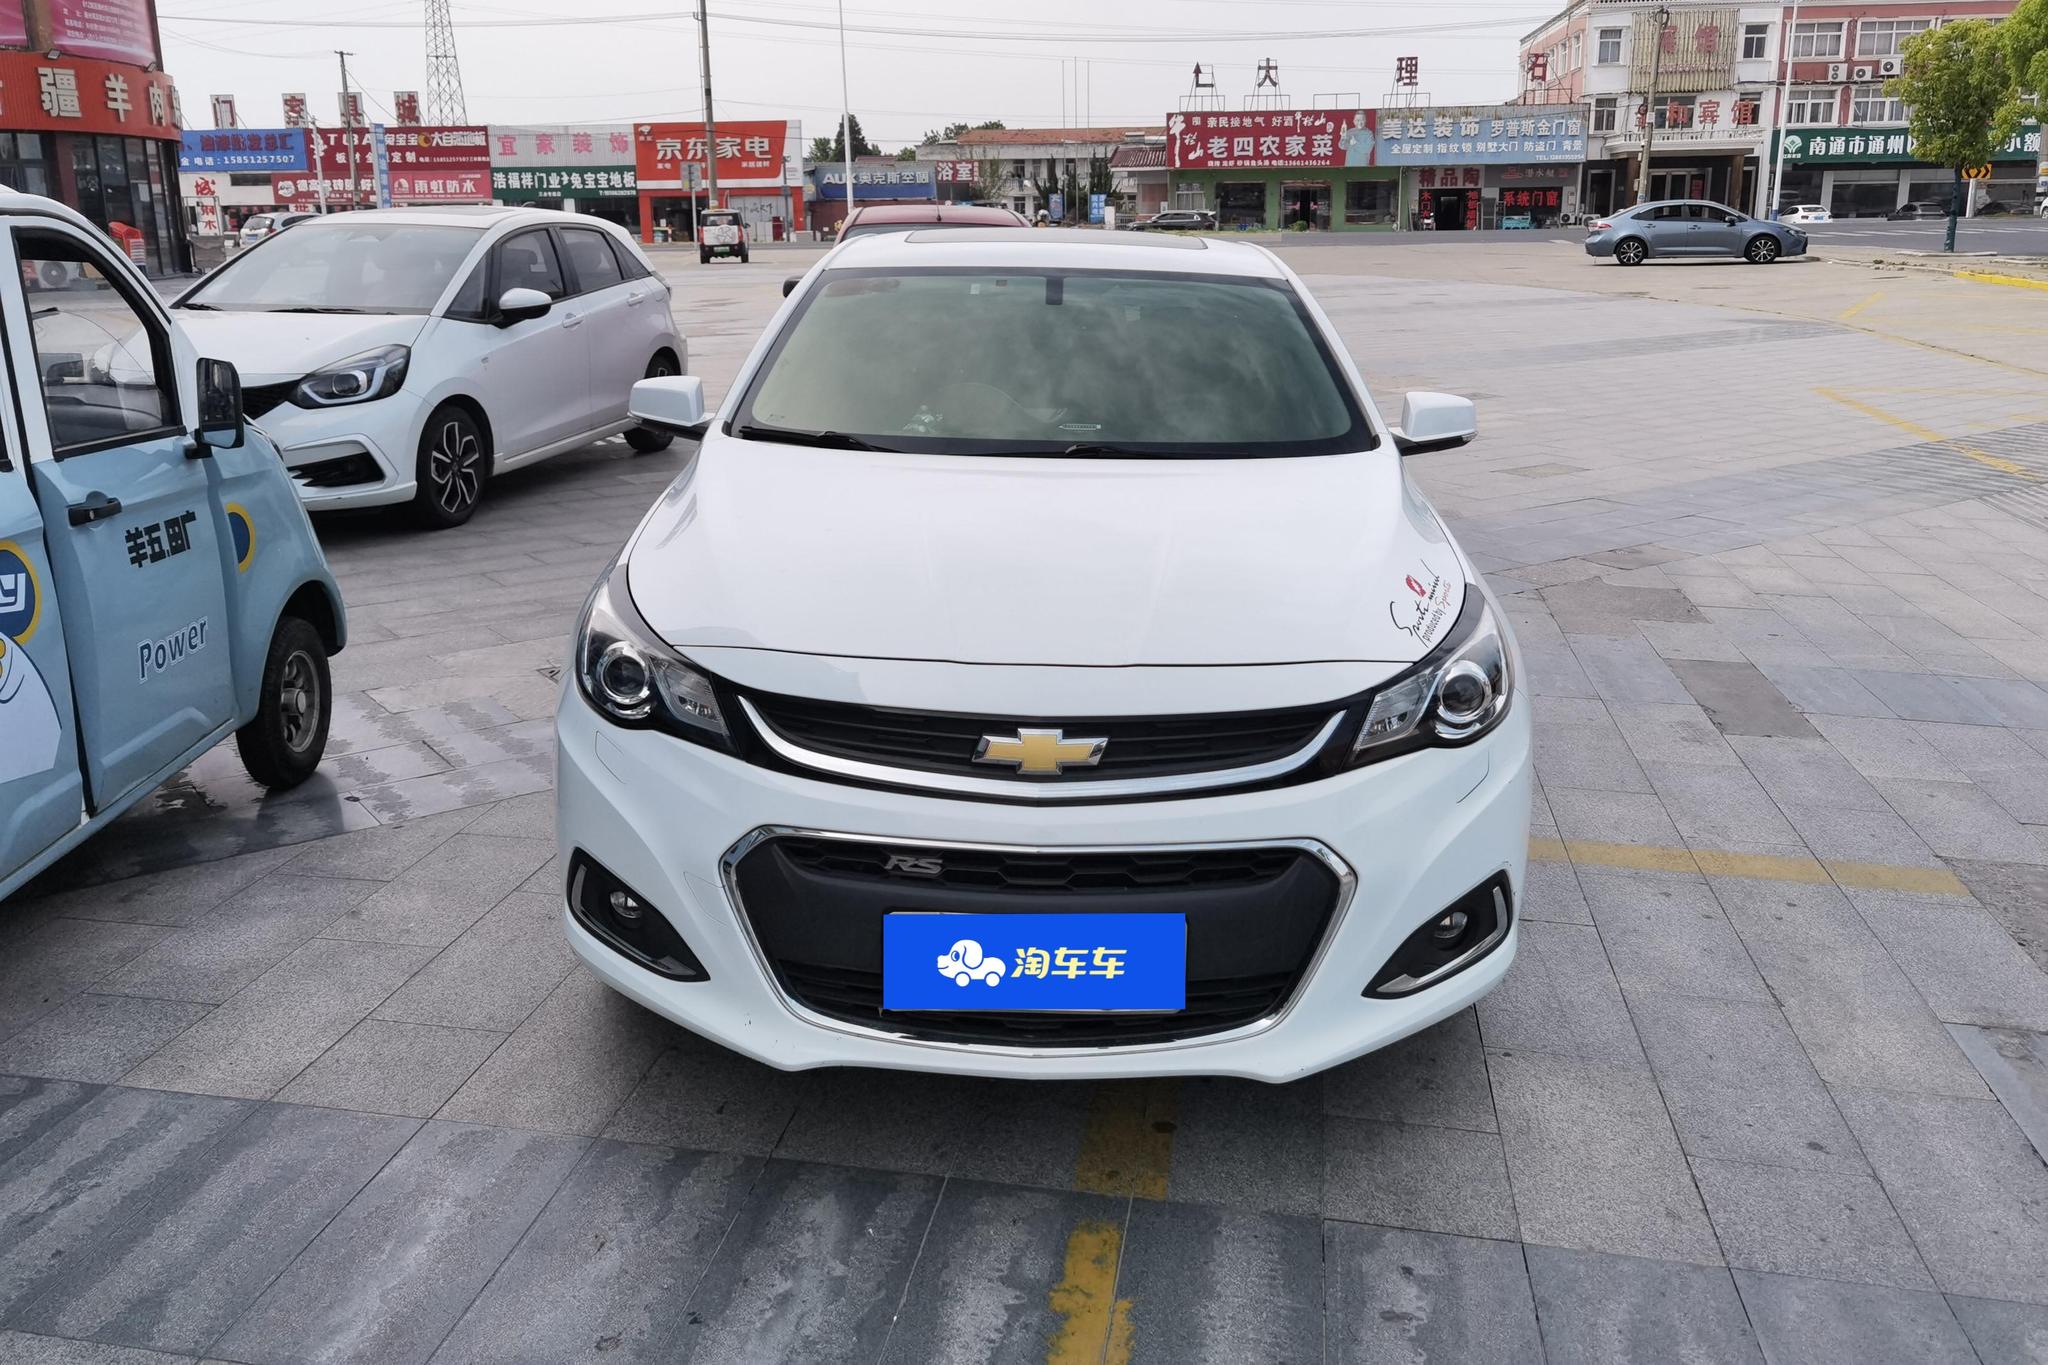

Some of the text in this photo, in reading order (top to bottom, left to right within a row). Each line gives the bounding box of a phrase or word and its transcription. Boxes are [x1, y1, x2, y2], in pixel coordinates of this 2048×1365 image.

[0, 67, 182, 129] 疆羊肉
[1207, 116, 1265, 128] 亲民接地气
[1382, 116, 1582, 140] 美达装饰 罗普斯金门窗
[497, 132, 629, 156] 宜家装饰
[656, 136, 772, 161] 京东家电
[1207, 134, 1334, 158] 老四农家菜
[1391, 143, 1433, 154] 全屋定制
[1437, 142, 1472, 154] 指纹锁
[1476, 141, 1518, 153] 别墅大门
[1523, 141, 1556, 152] 防盗门
[493, 171, 636, 189] 浩福祥门业 兔宝宝地板
[937, 162, 973, 182] 浴室
[414, 180, 477, 194] 雨虹防水
[1503, 191, 1560, 208] 系统门窗
[136, 616, 209, 683] Power
[884, 855, 945, 875] RS
